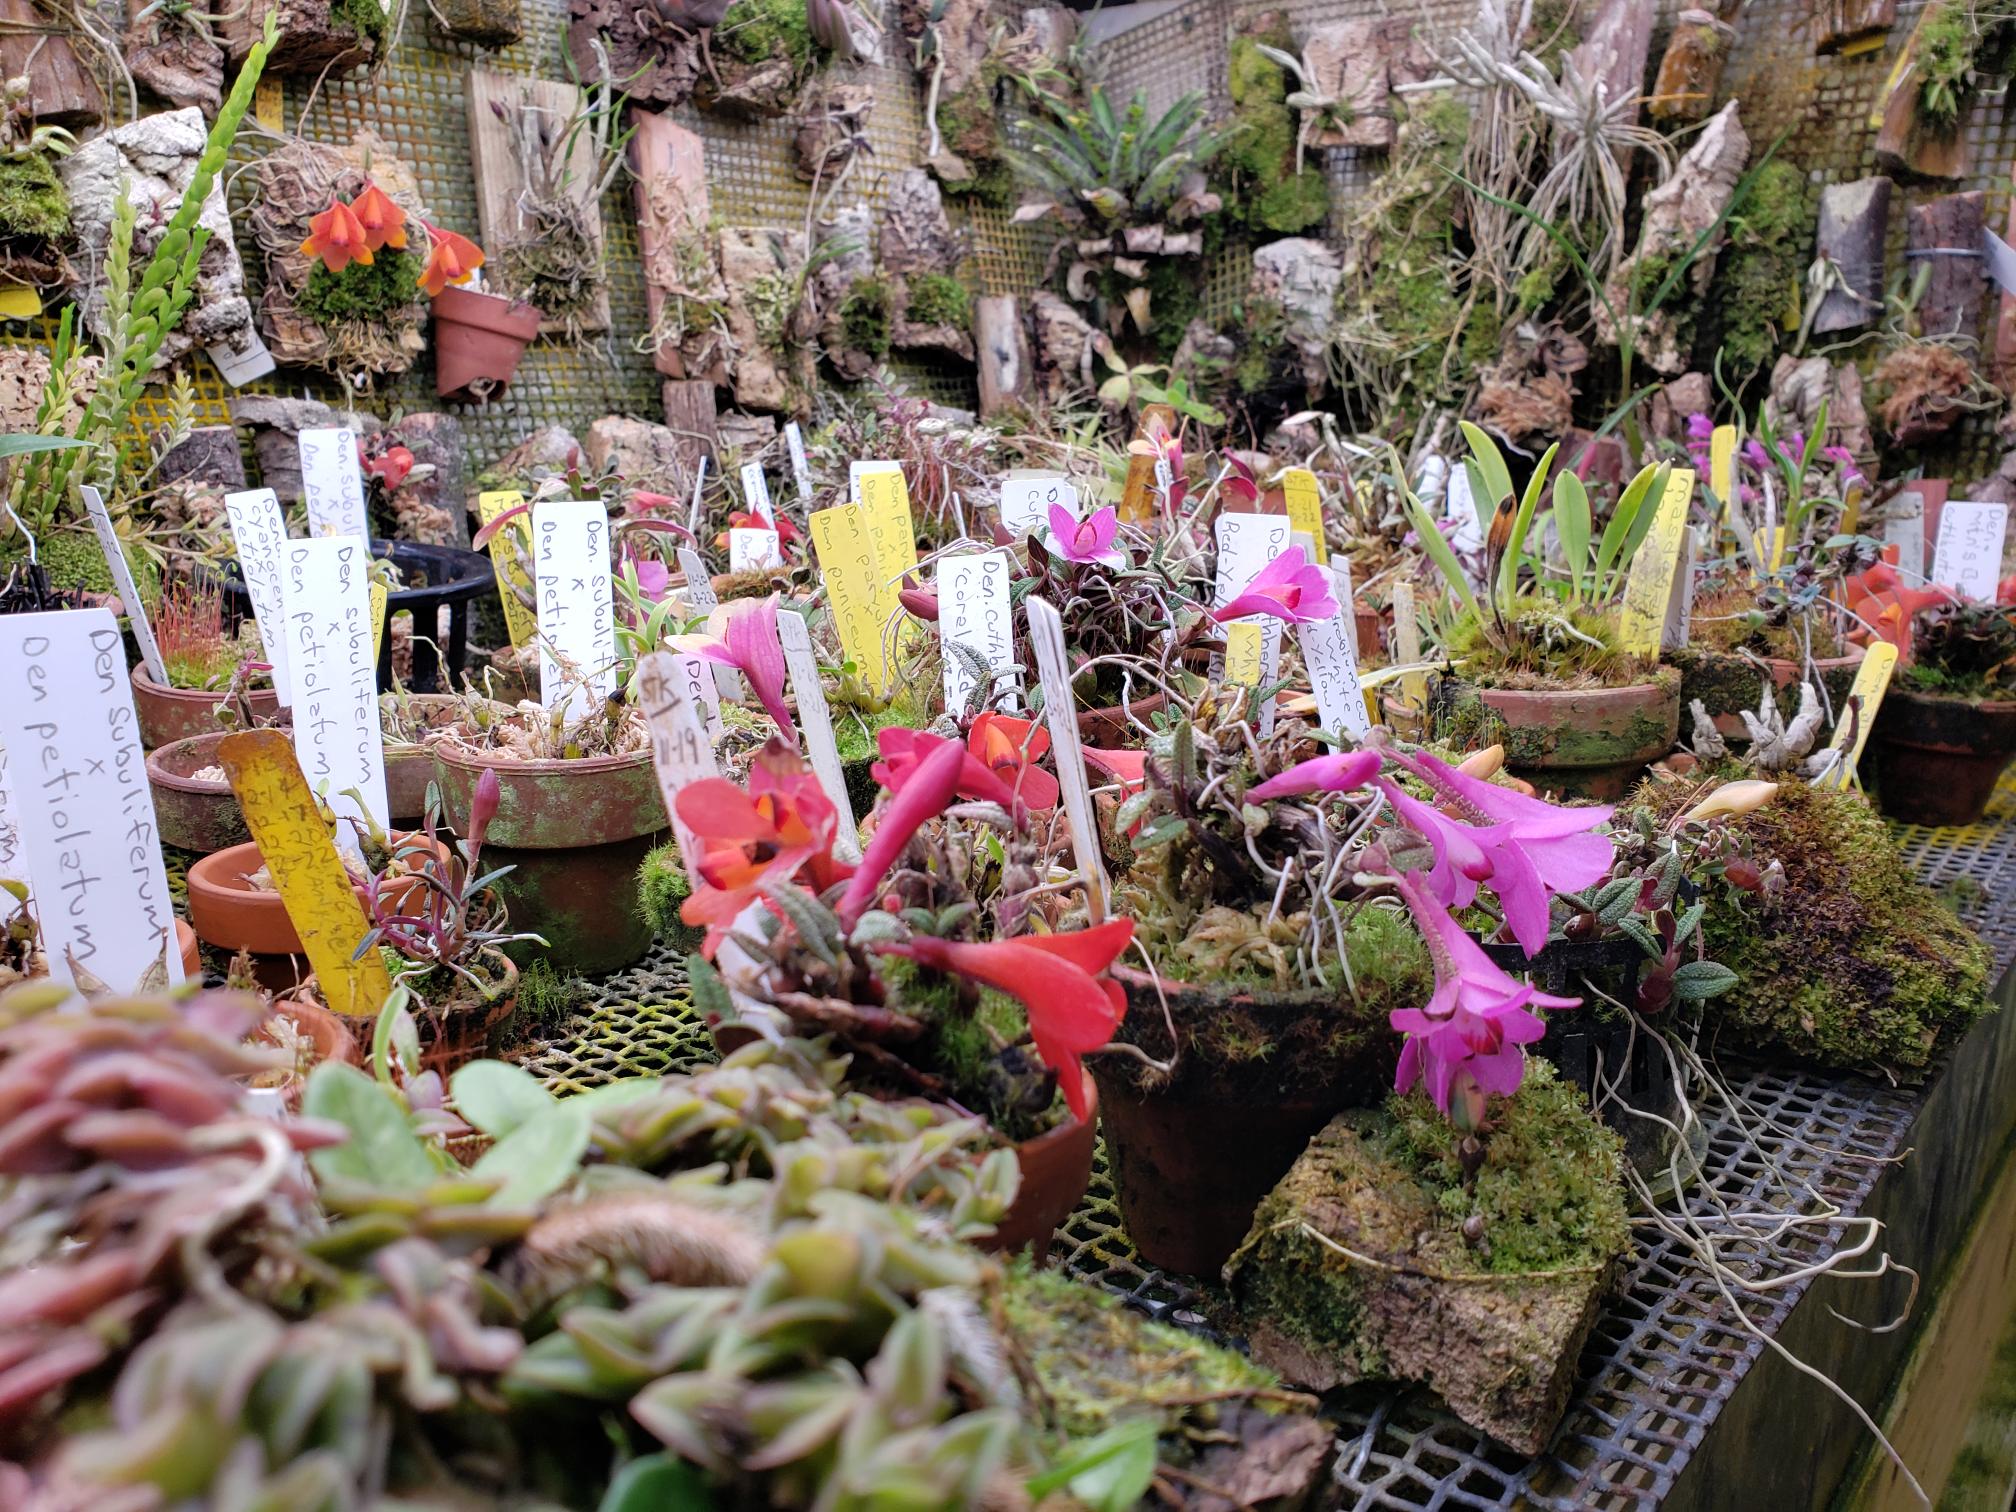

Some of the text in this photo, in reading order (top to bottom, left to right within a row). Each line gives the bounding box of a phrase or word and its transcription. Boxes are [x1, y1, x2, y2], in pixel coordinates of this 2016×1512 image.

[540, 521, 557, 561] Den
[819, 516, 868, 671] Den puniceum
[982, 561, 1000, 606] Den.
[291, 548, 338, 775] Den petiolatum
[327, 622, 341, 636] x
[338, 546, 371, 784] Den subuliferum
[23, 636, 101, 961] Den petiolatum
[84, 758, 106, 776] x
[89, 629, 119, 694] Den
[108, 706, 162, 941] subuliferum
